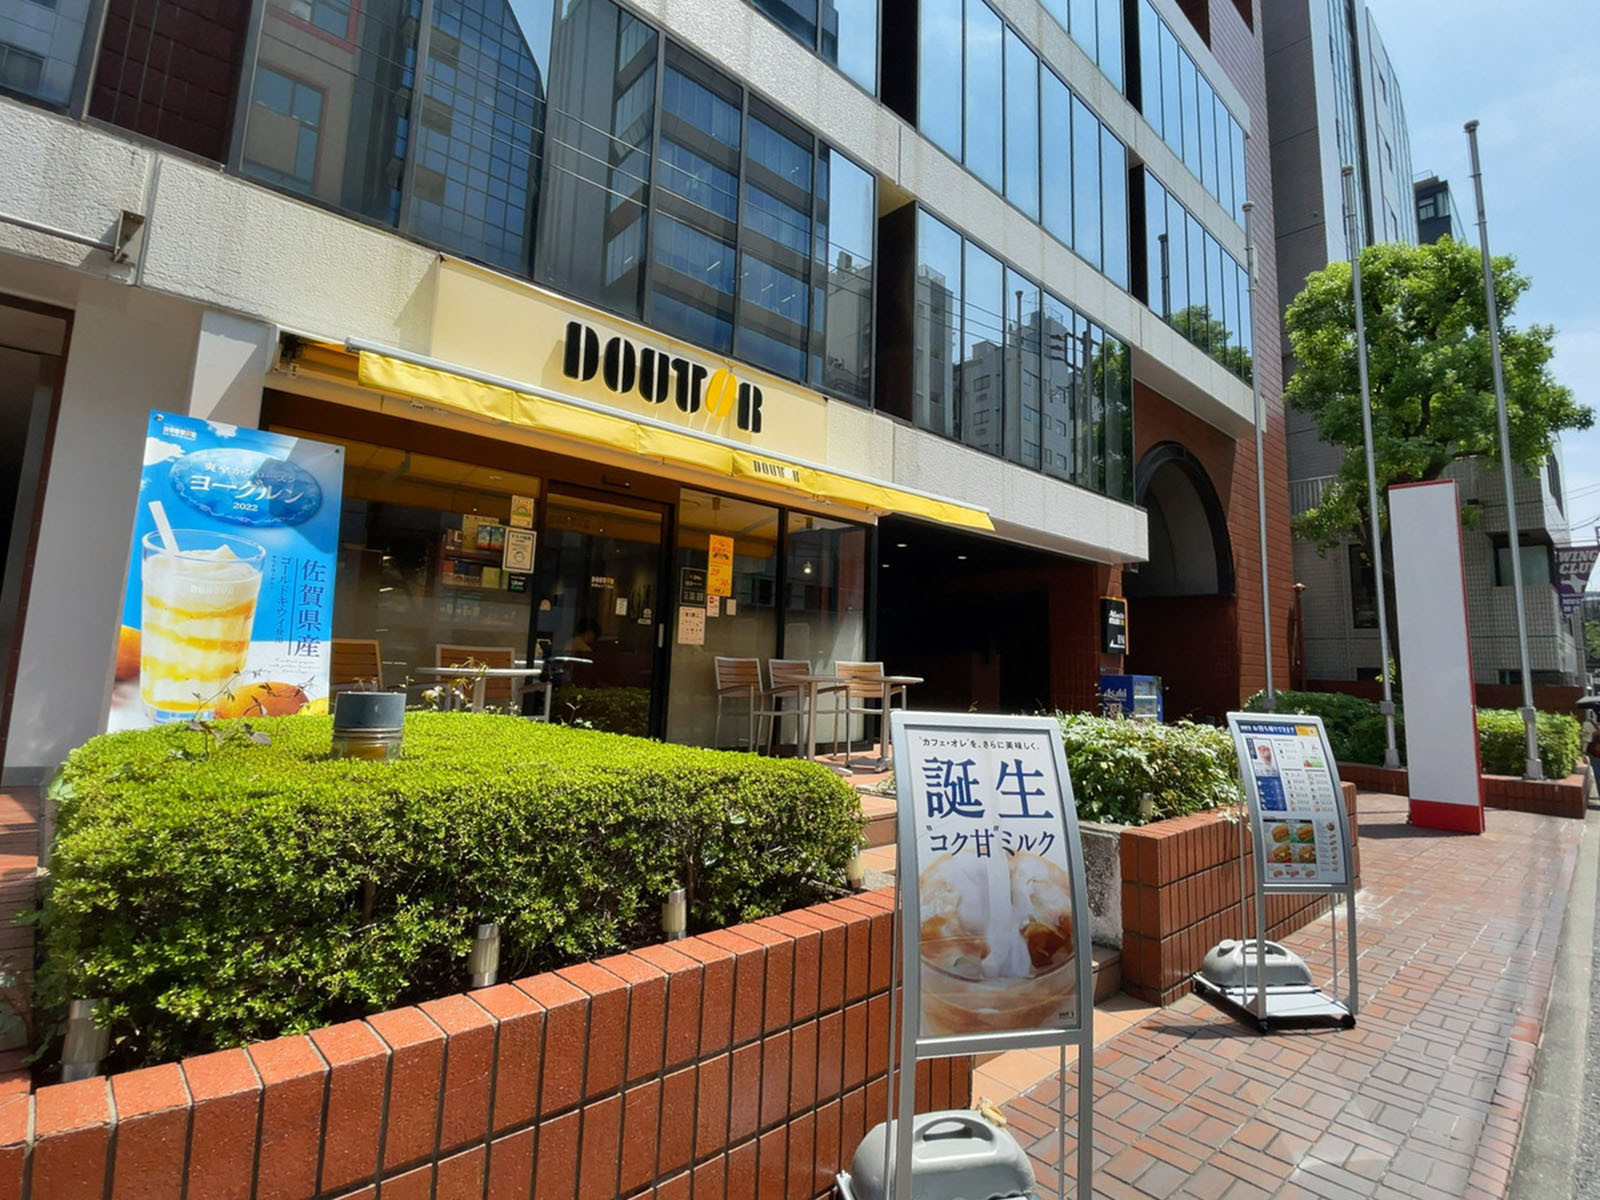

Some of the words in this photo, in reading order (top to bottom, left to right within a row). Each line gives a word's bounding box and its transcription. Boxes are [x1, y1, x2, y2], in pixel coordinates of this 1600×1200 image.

[563, 321, 764, 434] DOUTOR
[190, 474, 304, 504] ヨーグルン
[233, 502, 259, 512] 2022
[294, 559, 327, 658] 佐賀県産
[921, 757, 1055, 819] 誕生
